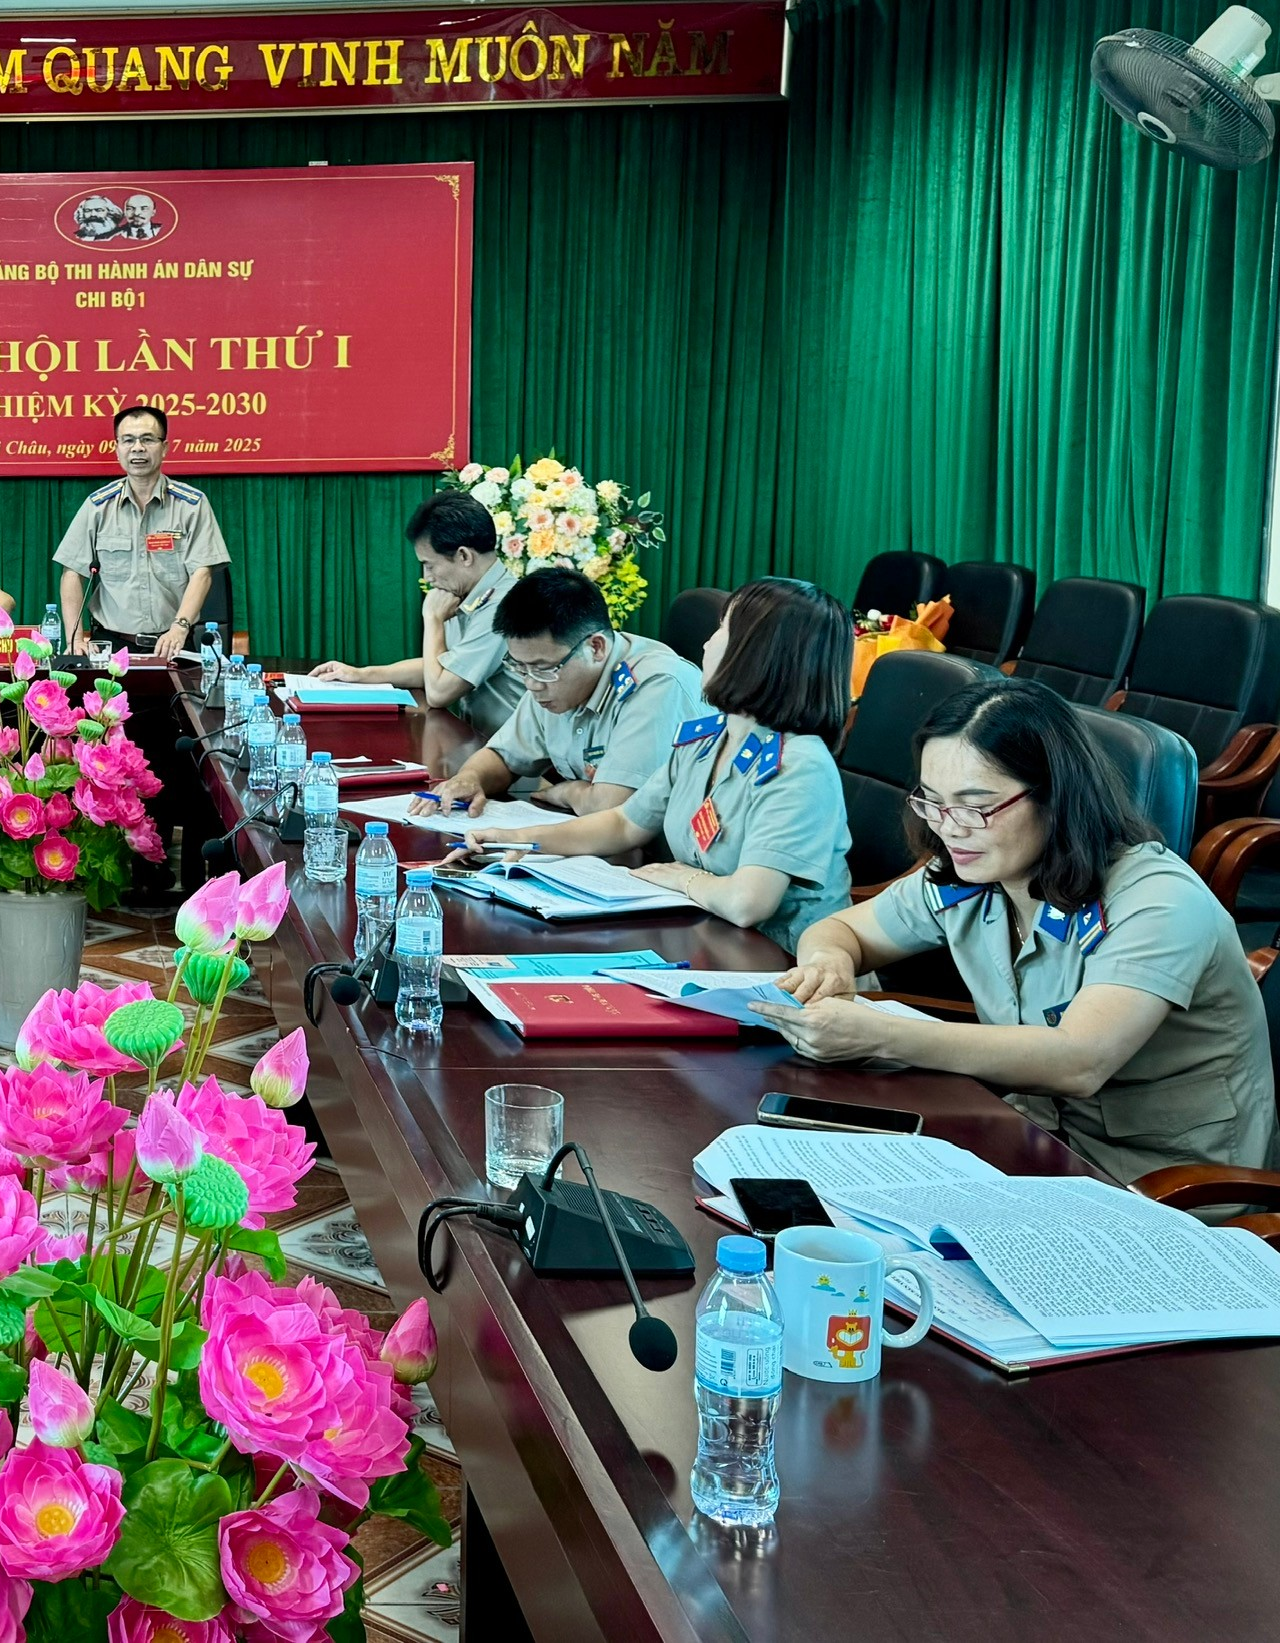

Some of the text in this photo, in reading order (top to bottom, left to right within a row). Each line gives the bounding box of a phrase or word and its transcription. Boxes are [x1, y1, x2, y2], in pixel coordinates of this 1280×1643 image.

[44, 45, 233, 96] QUANG
[259, 40, 403, 88] VINH
[425, 20, 590, 83] MUÔN
[607, 18, 735, 79] NĂM
[35, 261, 59, 285] BỘ
[64, 264, 93, 280] THI
[98, 260, 148, 280] HÀNH
[152, 259, 179, 279] ÁN
[184, 258, 222, 278] DÂN
[227, 258, 255, 281] SỰ
[75, 291, 106, 308] CHI
[94, 328, 197, 372] LẦN
[210, 325, 324, 371] THỨ
[333, 335, 353, 369] I
[83, 387, 127, 417] KỲ
[5, 440, 52, 457] Châu,
[56, 440, 94, 458] ngày
[98, 440, 117, 454] 09
[184, 439, 219, 453] năm
[223, 437, 262, 453] 2025
